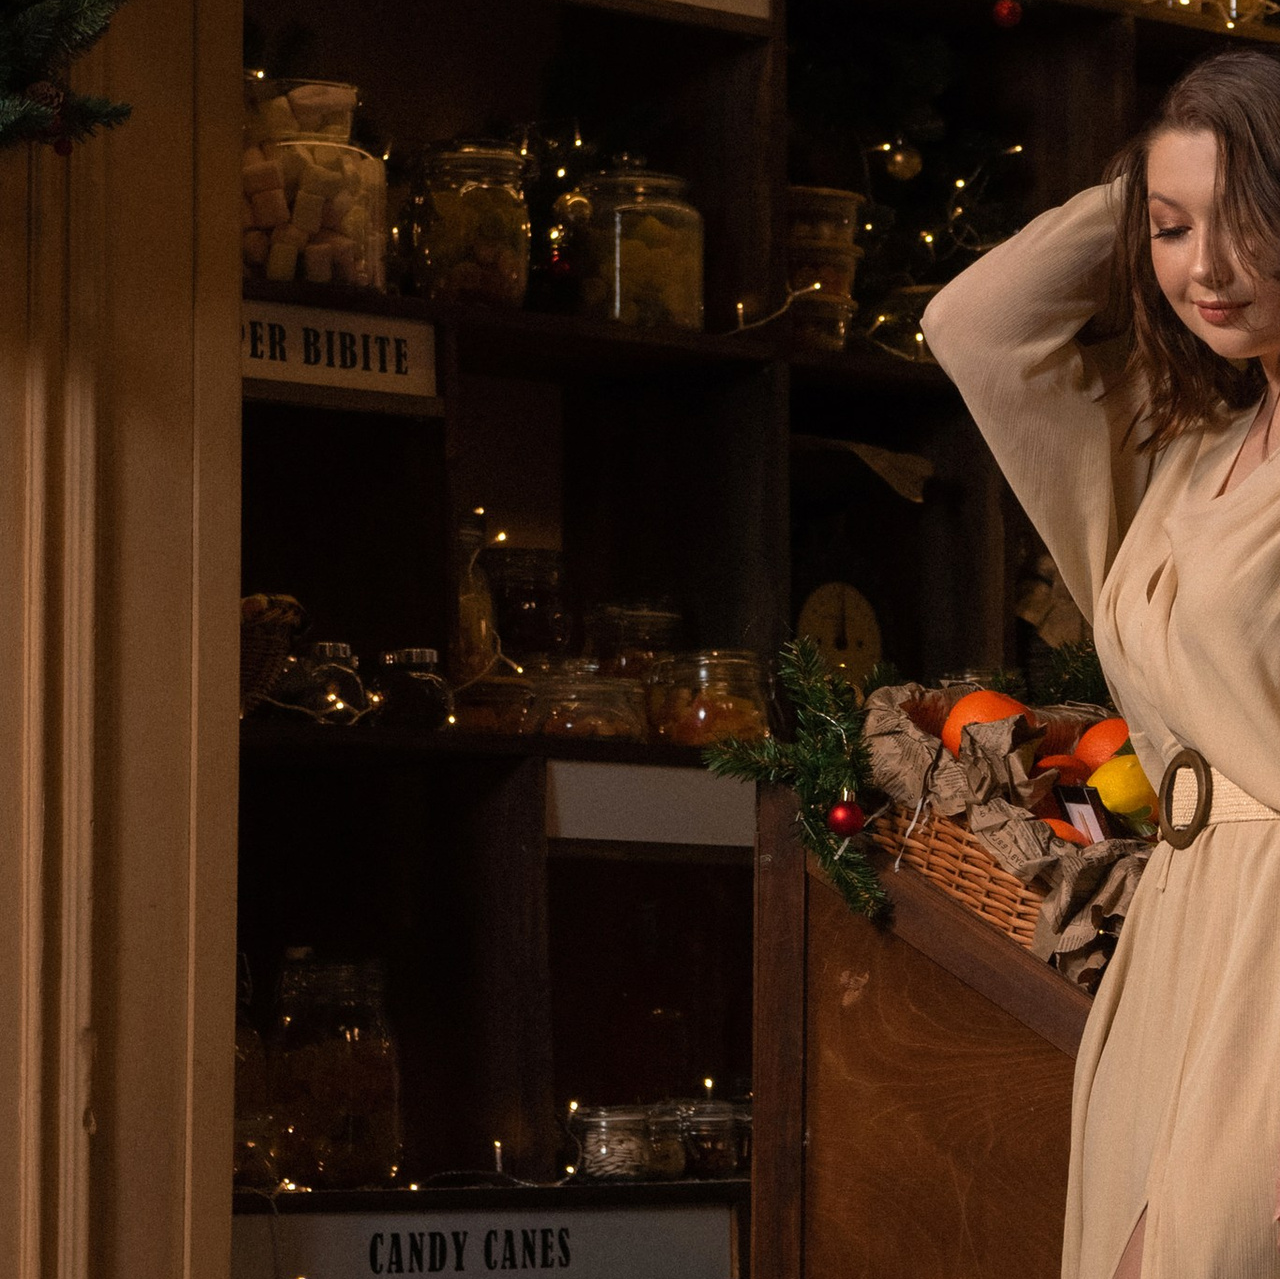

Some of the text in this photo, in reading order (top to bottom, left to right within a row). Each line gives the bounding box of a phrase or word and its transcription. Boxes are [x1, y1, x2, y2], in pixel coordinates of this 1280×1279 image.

[241, 320, 409, 376] ER BIBITE
[368, 1226, 572, 1275] CANDY CANES
